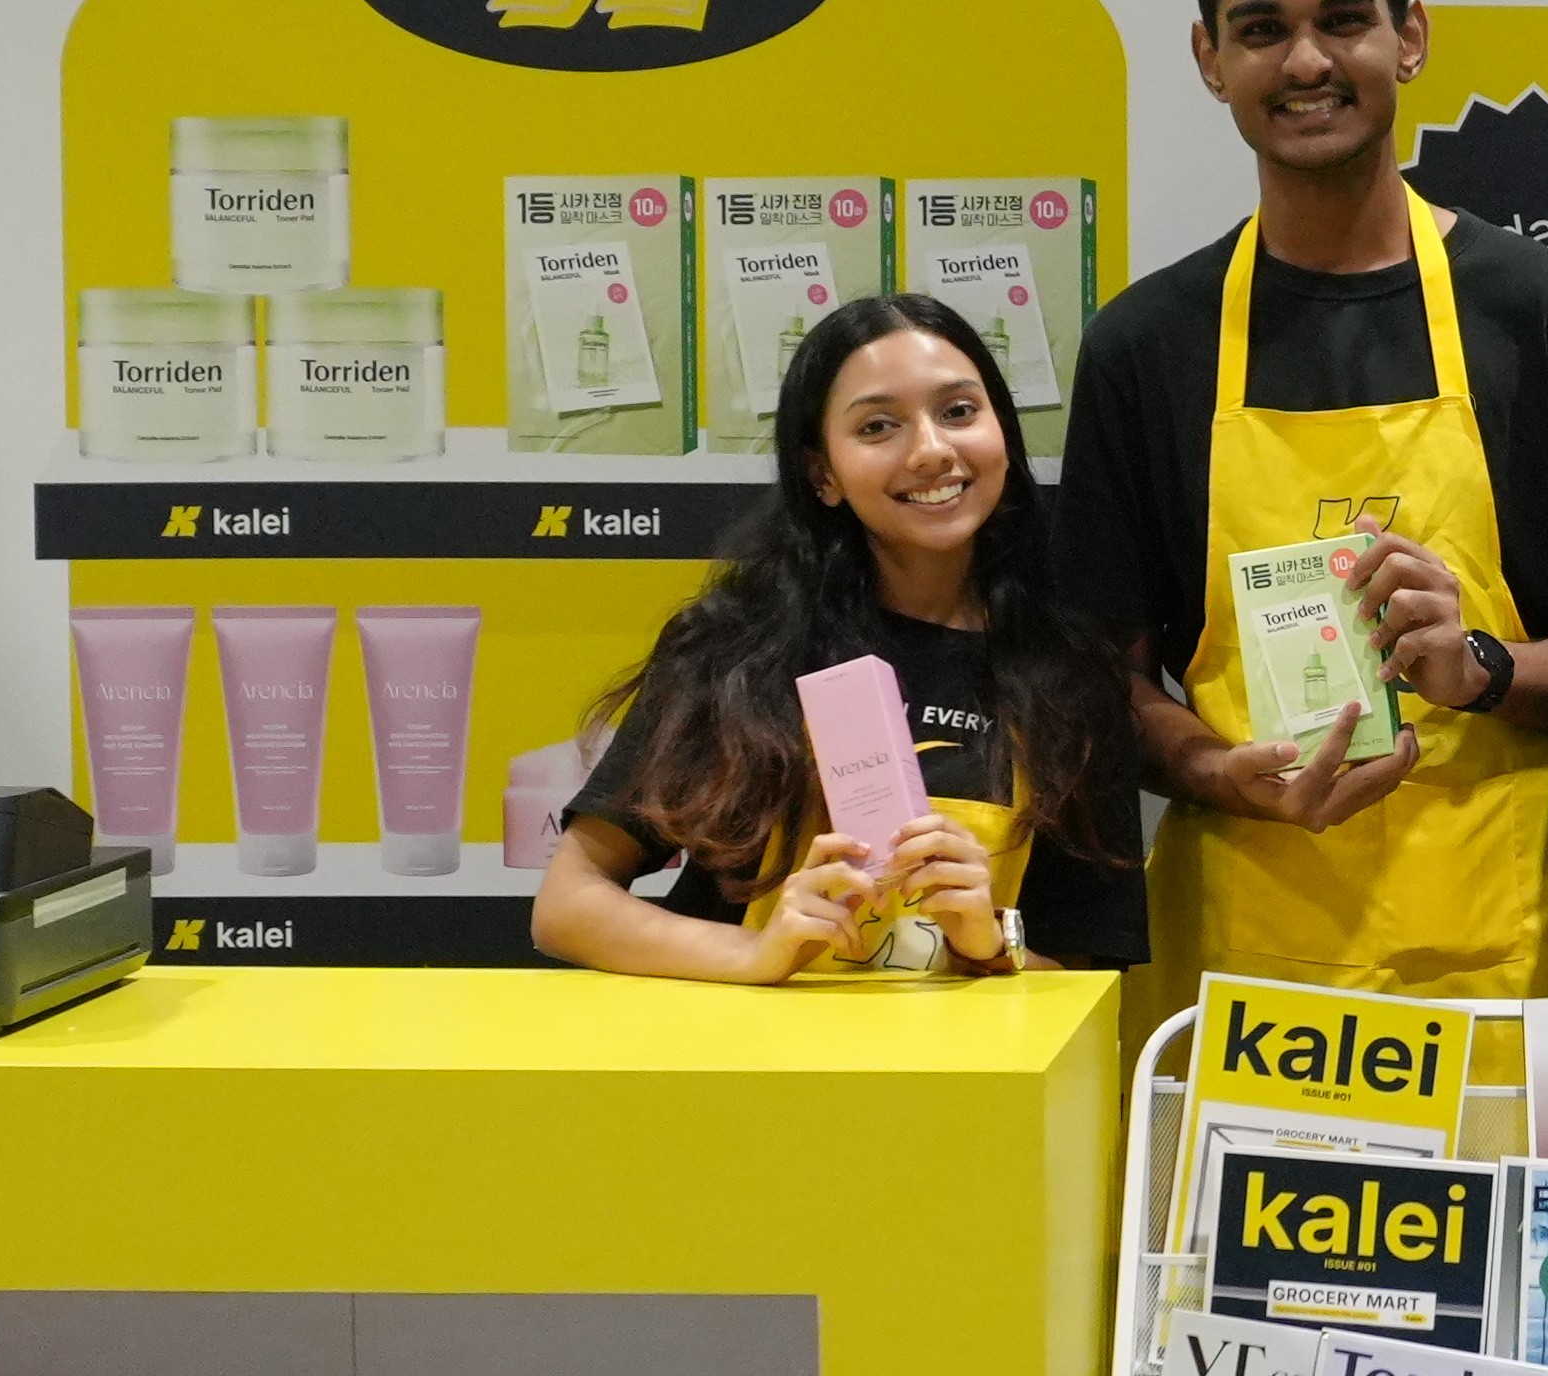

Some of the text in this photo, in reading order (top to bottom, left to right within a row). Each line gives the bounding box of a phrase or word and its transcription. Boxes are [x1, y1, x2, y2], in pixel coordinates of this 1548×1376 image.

[204, 188, 315, 212] Torriden
[516, 192, 556, 225] 1등
[560, 192, 622, 210] 시카 진정
[716, 193, 756, 226] 1등
[760, 193, 822, 210] 시카 진정
[918, 194, 957, 227] 1등
[961, 195, 1023, 212] 시카 진정
[537, 251, 619, 274] Torriden
[737, 252, 819, 275] Torriden
[937, 253, 1019, 275] Torriden
[113, 359, 223, 384] Torriden
[300, 358, 410, 383] Torriden
[212, 506, 290, 536] kalei
[582, 505, 662, 537] kalei
[1240, 563, 1273, 592] 1등
[1275, 555, 1324, 575] 시카 진정
[1261, 600, 1327, 628] Torriden
[95, 681, 172, 701] Arencia
[239, 680, 315, 701] Arencia
[380, 680, 458, 701] Arencia
[922, 705, 995, 734] EVERY
[829, 750, 891, 782] Arencia
[215, 918, 293, 950] kalei
[1222, 999, 1443, 1098] kalei
[1301, 1087, 1353, 1103] ISSUE #01
[1274, 1127, 1359, 1147] GROCERY MART
[1241, 1170, 1467, 1265] kalei
[1323, 1257, 1378, 1274] ISSUE #01
[1272, 1285, 1421, 1313] GROCERY MART
